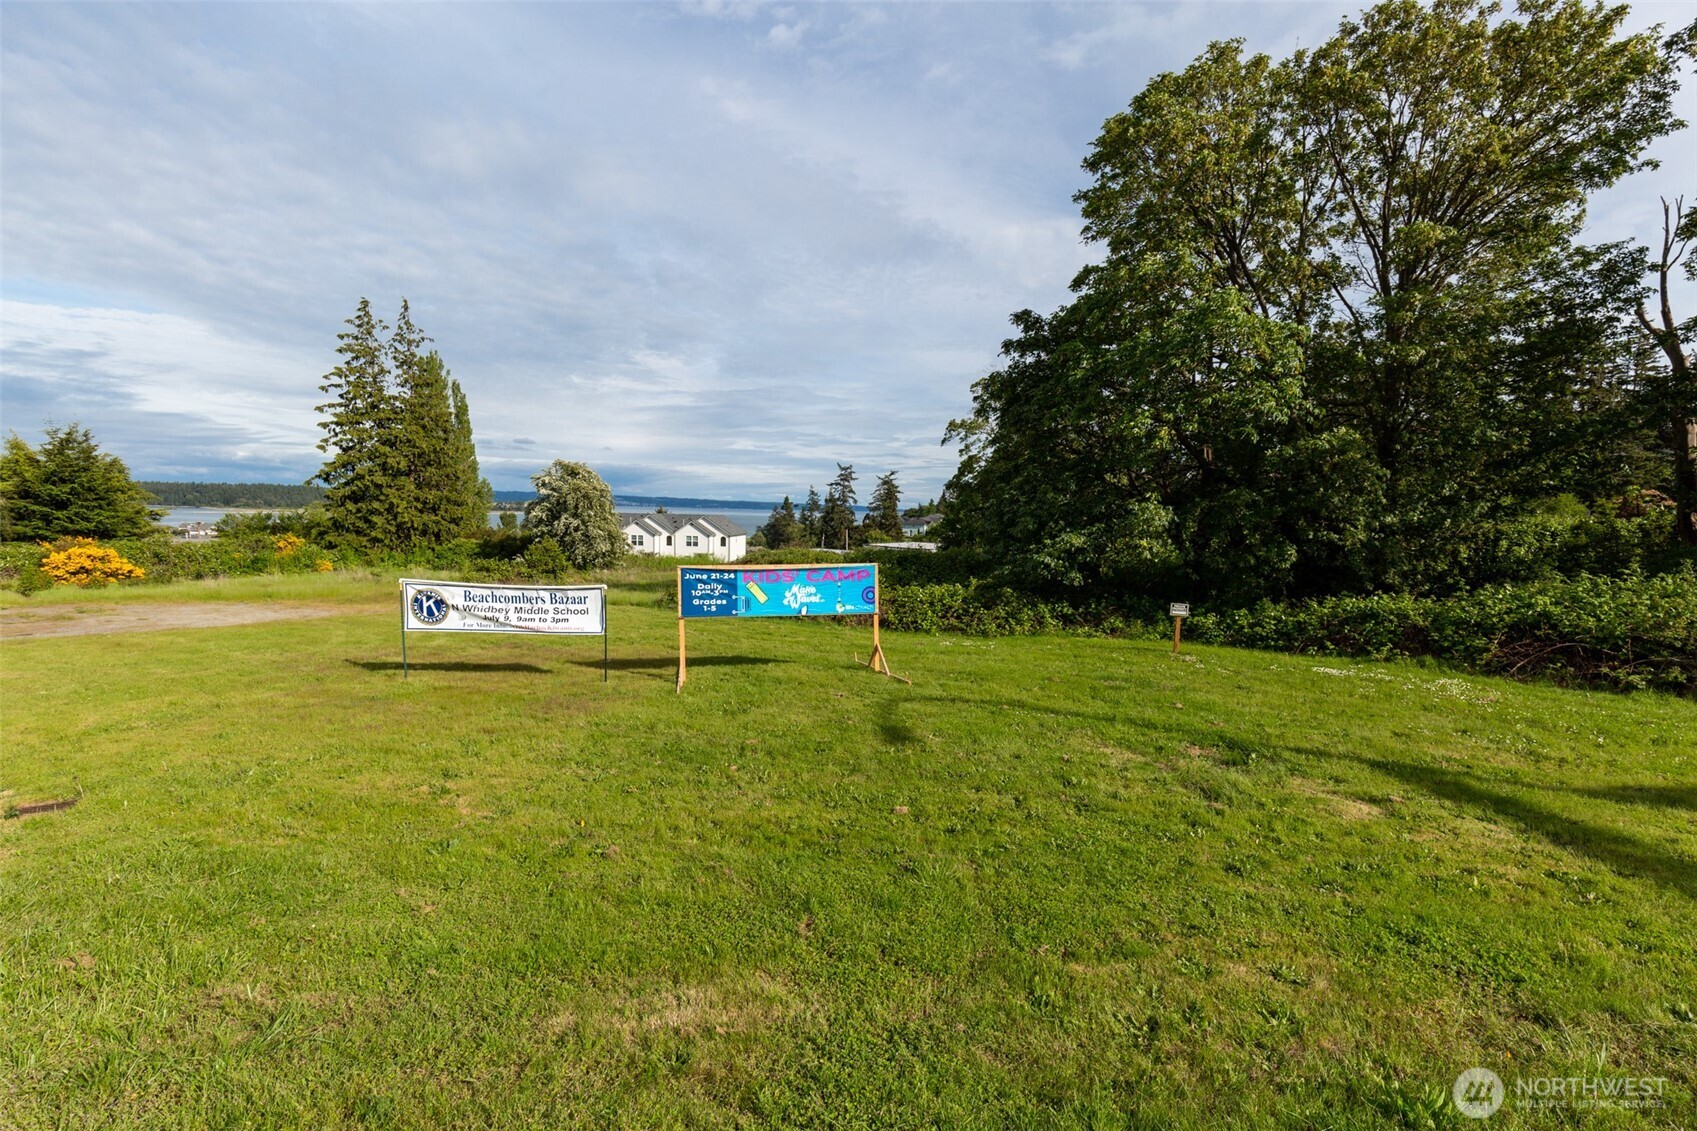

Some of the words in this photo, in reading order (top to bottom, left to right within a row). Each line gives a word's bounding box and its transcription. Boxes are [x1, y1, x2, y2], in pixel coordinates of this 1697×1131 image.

[806, 570, 871, 582] CAMP
[463, 589, 546, 605] Beachcombers
[549, 592, 589, 605] Bazaar
[784, 583, 817, 597] Make
[413, 602, 447, 623] INTERNATIONAL
[422, 595, 439, 617] K
[451, 603, 460, 612] N
[463, 604, 510, 615] Whidbey
[513, 606, 550, 616] Middle
[552, 606, 589, 616] School
[482, 614, 500, 622] July
[516, 615, 536, 623] 9am
